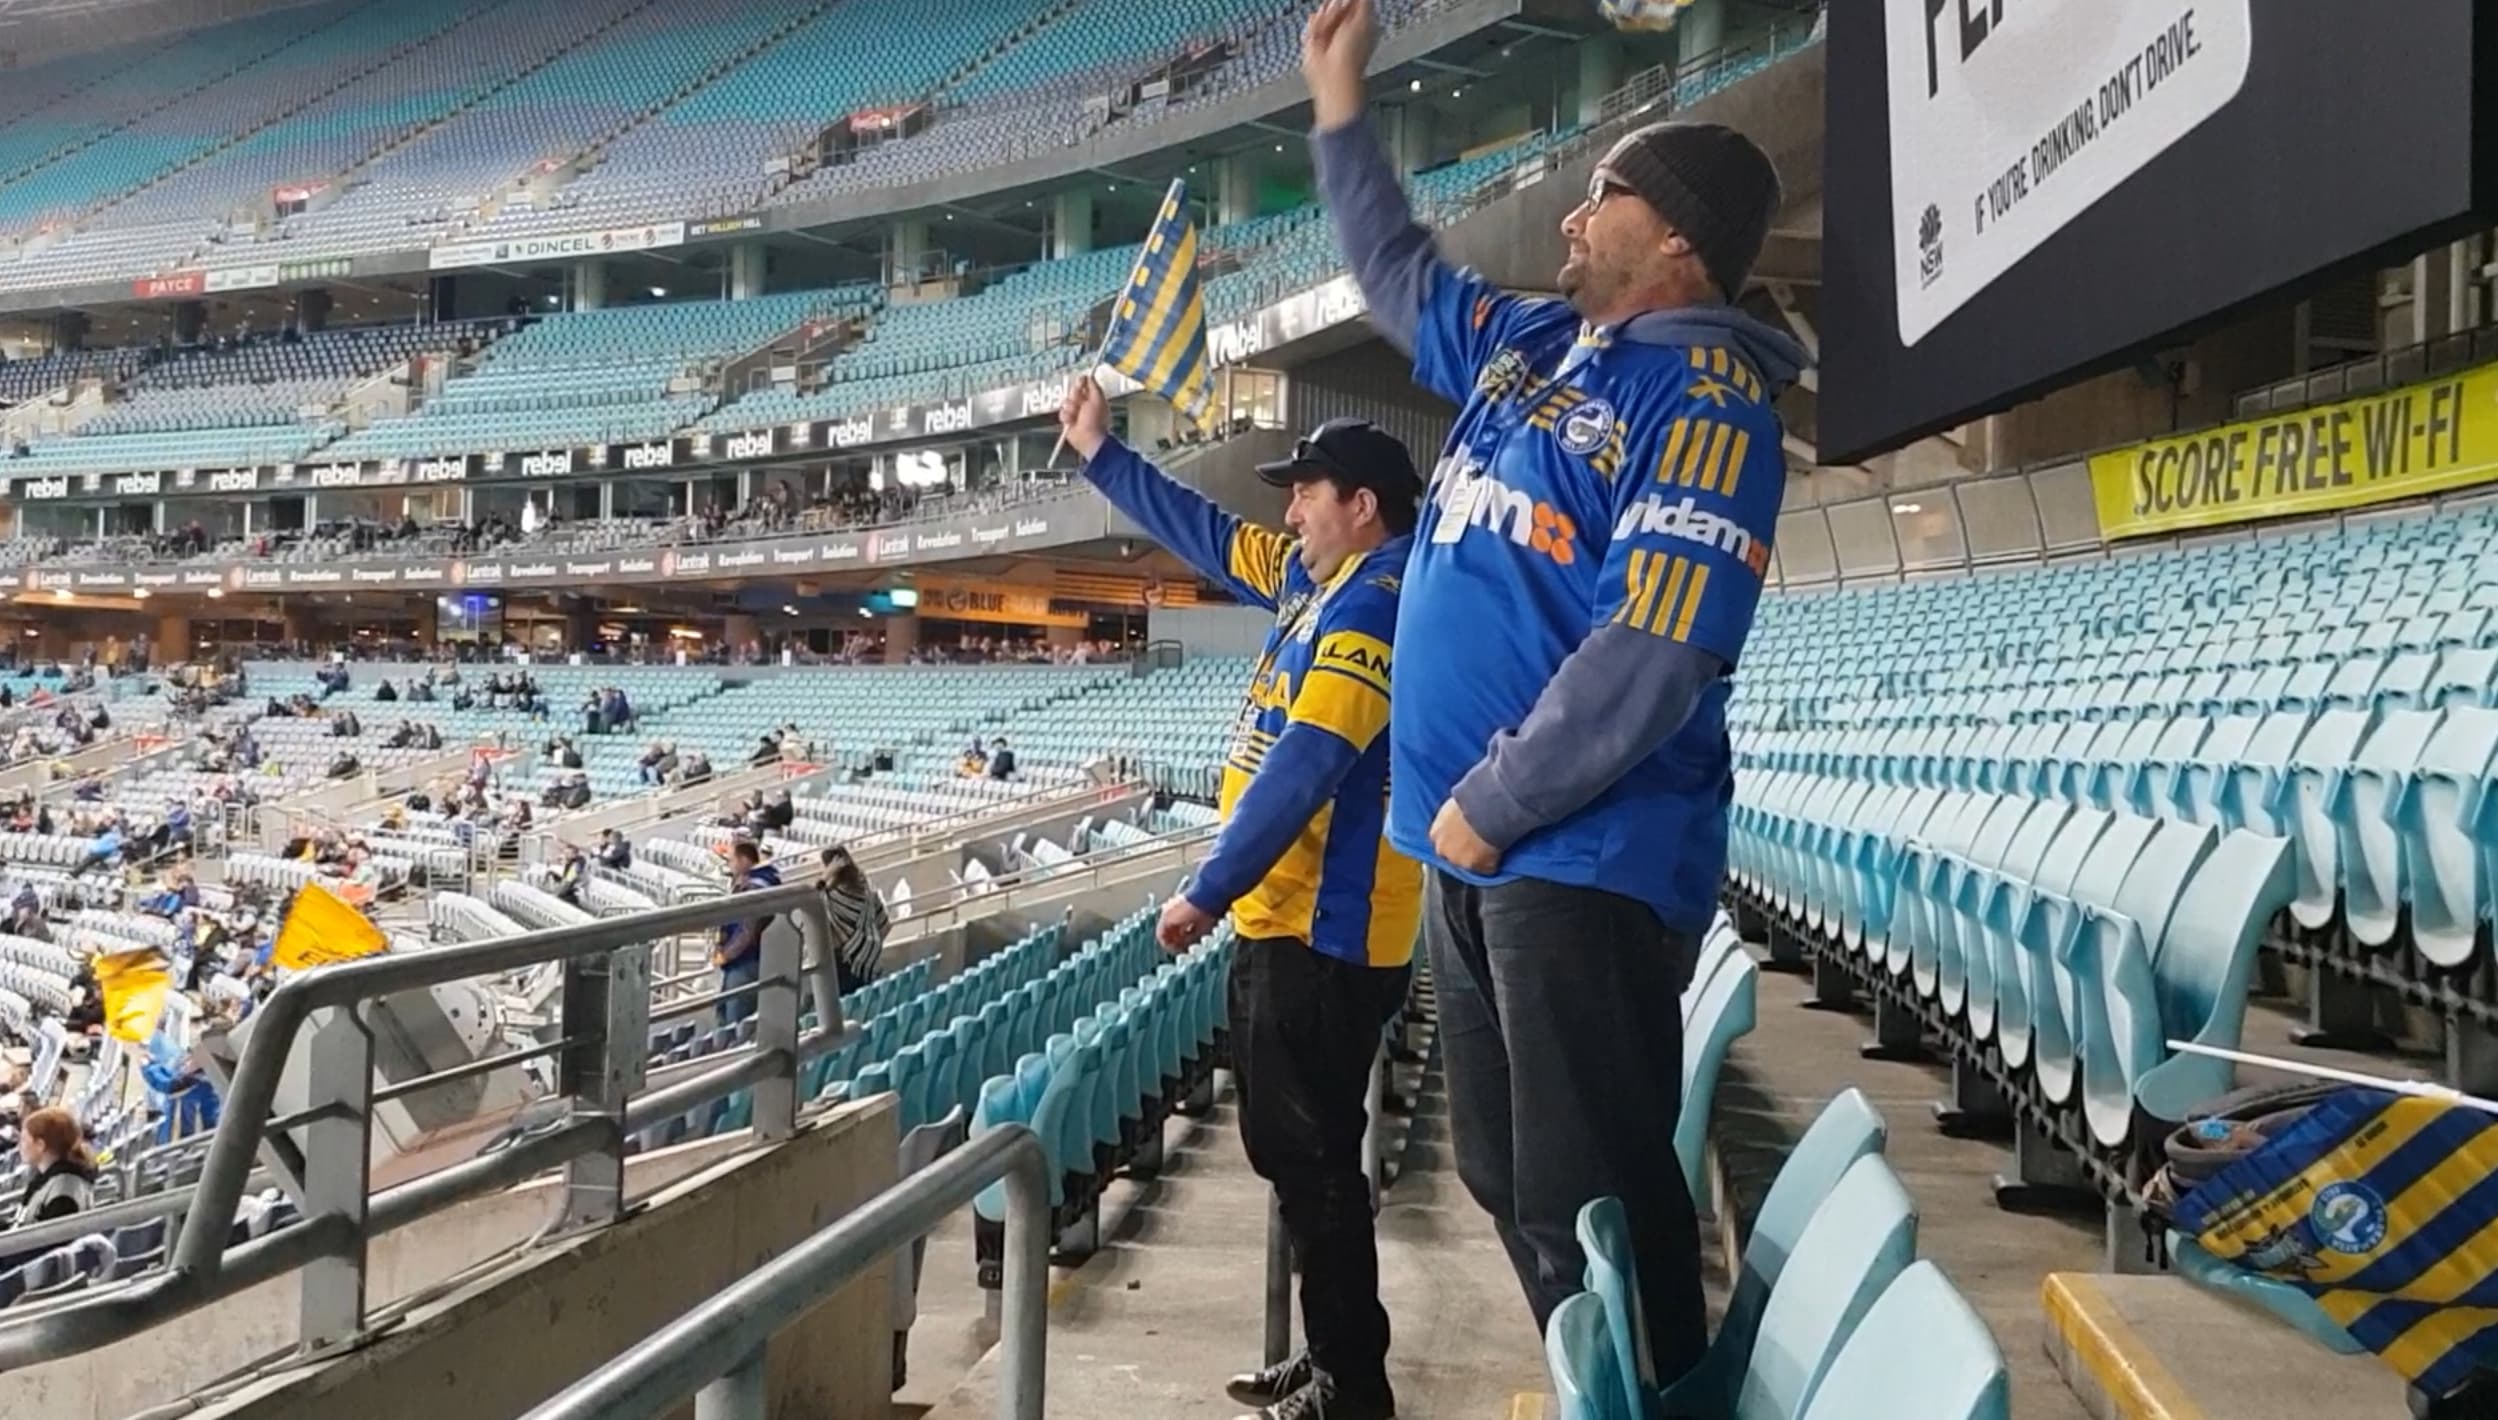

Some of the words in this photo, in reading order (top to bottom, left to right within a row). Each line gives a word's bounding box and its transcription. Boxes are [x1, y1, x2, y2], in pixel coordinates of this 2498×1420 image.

[1987, 156, 2028, 222] YOU'RE
[2031, 97, 2099, 187] DRINKING,
[2099, 53, 2142, 130] DON'T
[2146, 8, 2202, 91] DRIVE.
[527, 238, 595, 255] DINCEL
[1920, 241, 1943, 281] NSW
[151, 278, 193, 293] PAYCE
[25, 476, 68, 499] rebel
[115, 471, 160, 495] rebel
[210, 467, 257, 490] rebel
[311, 461, 360, 486] rebel
[418, 455, 467, 480] rebel
[521, 450, 571, 476] rebel
[624, 439, 672, 469] rebel
[727, 429, 772, 459] rebel
[828, 414, 873, 447] rebel
[925, 398, 973, 433] rebel
[1022, 375, 1069, 416] rebel
[2133, 431, 2247, 516] SCORE
[2252, 410, 2353, 497] FREE
[2363, 382, 2464, 480] WI-FI
[1612, 492, 1751, 563] yldam
